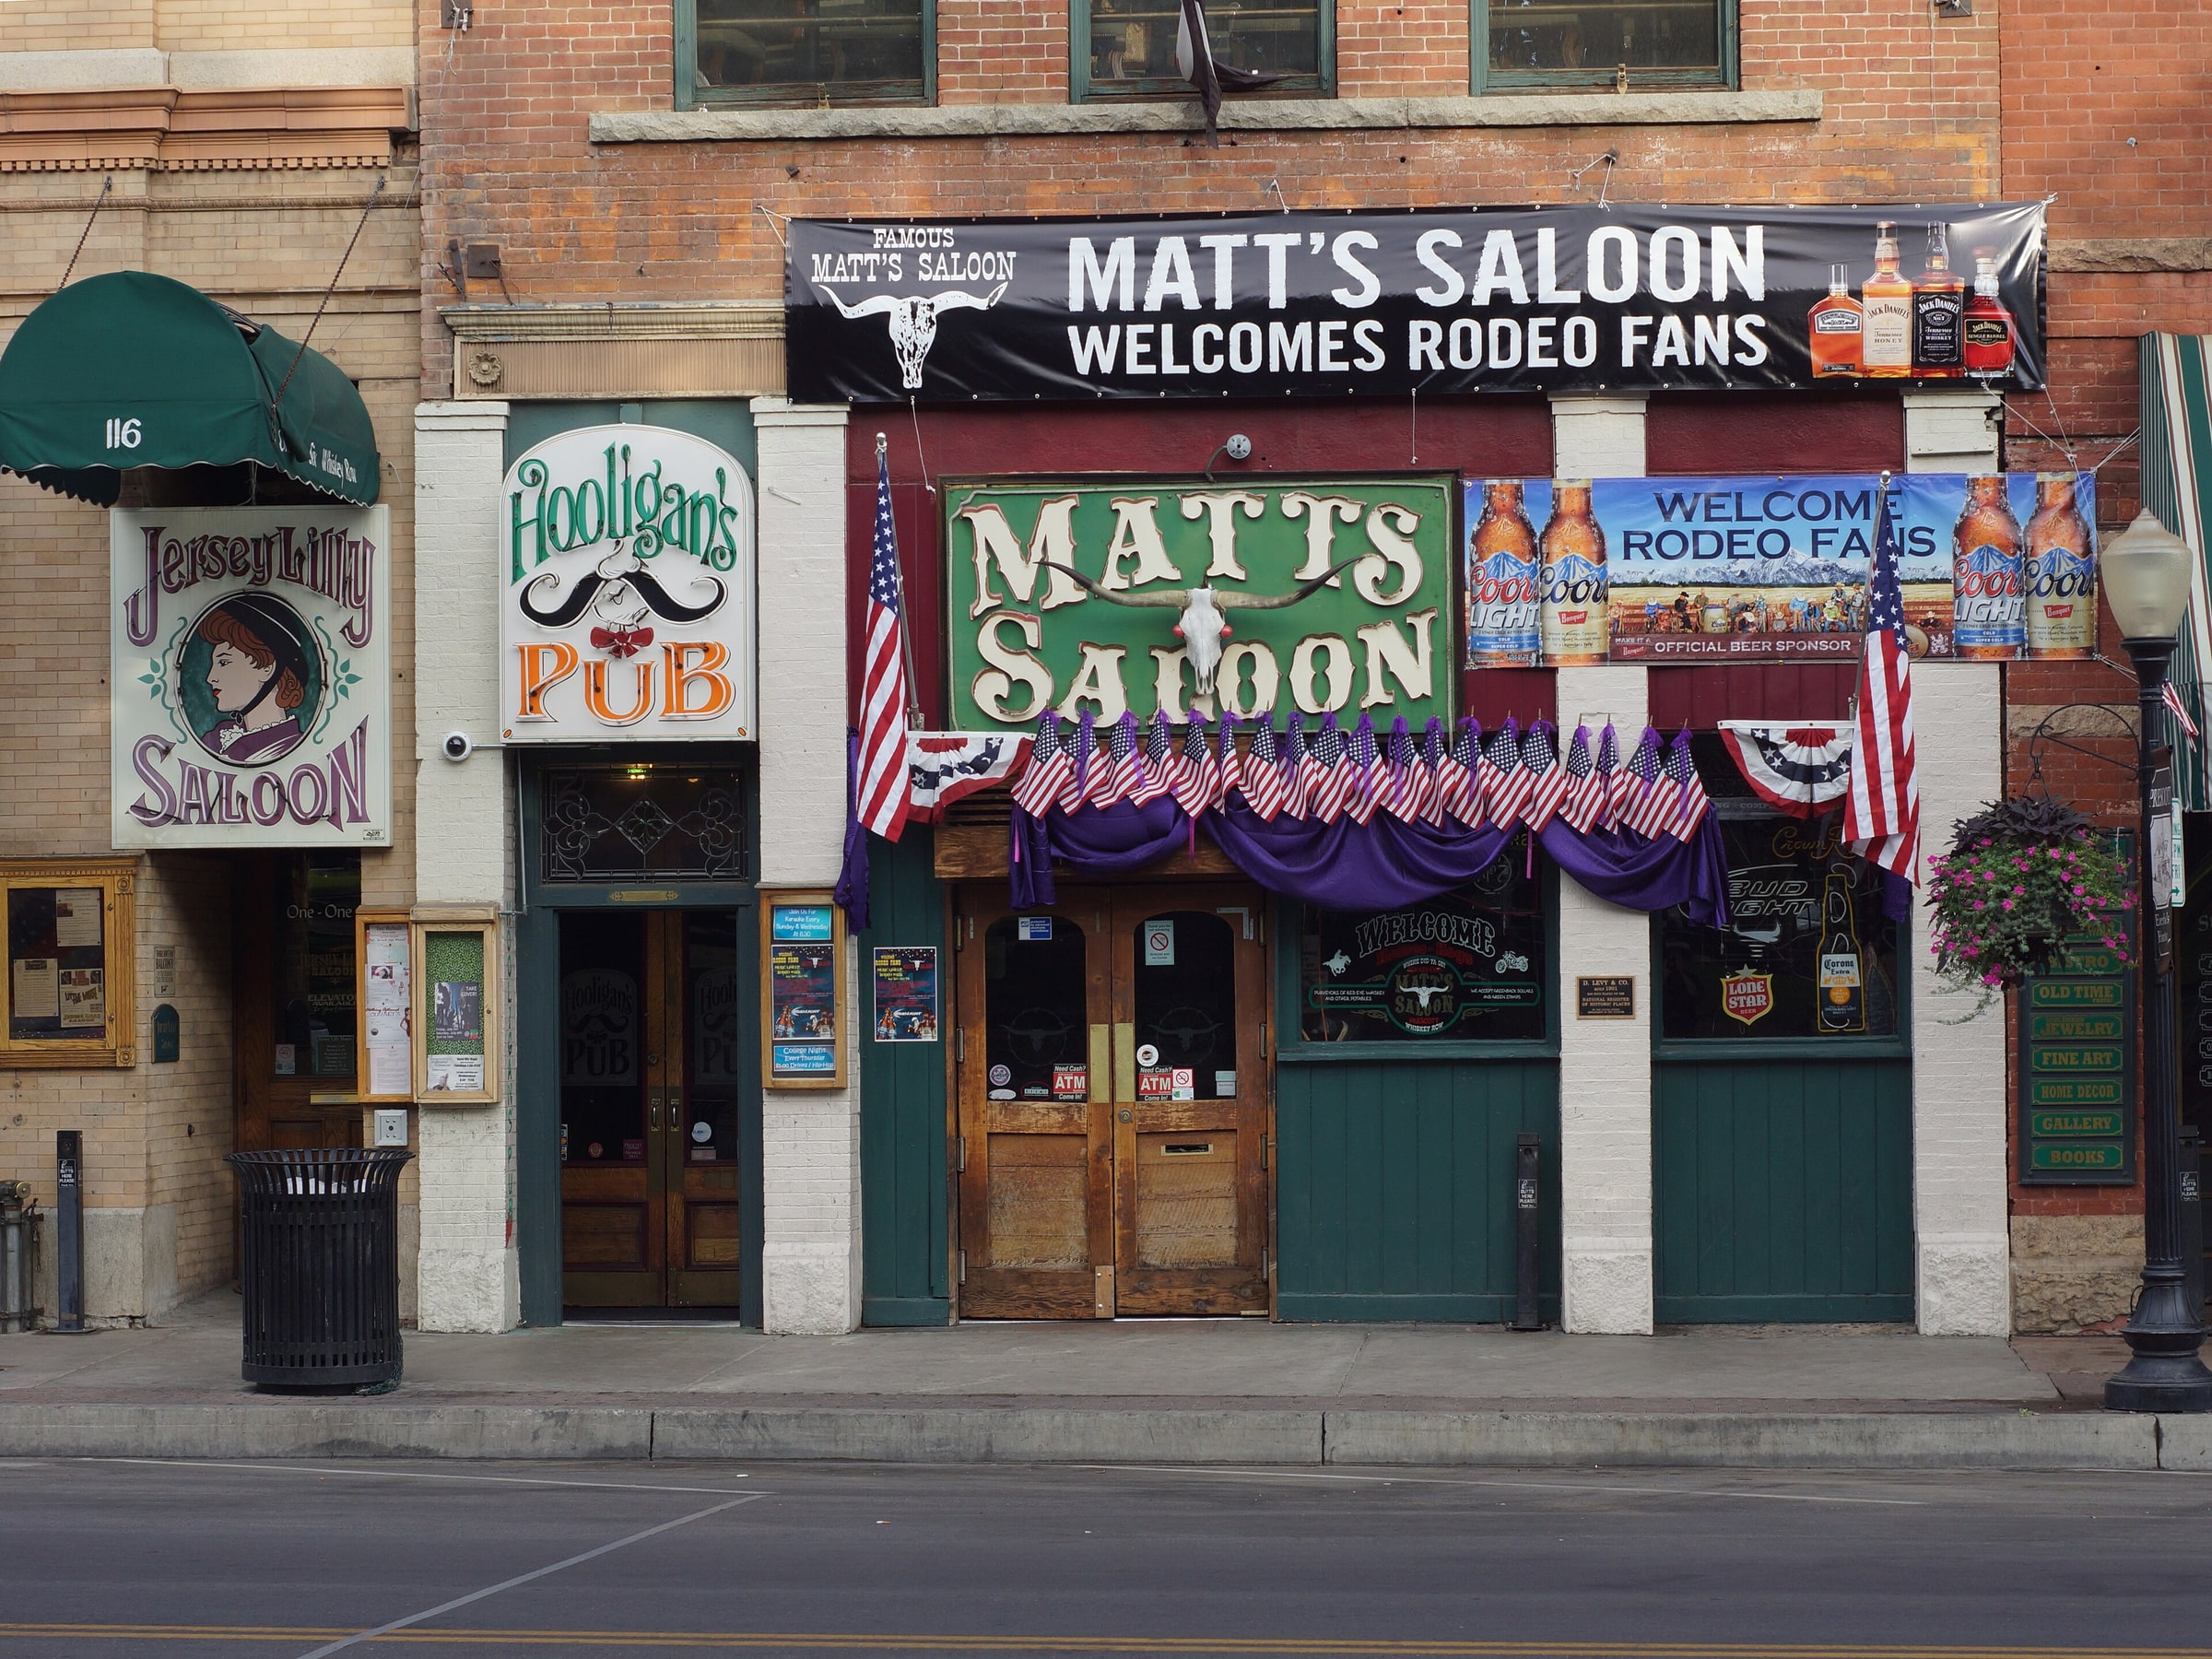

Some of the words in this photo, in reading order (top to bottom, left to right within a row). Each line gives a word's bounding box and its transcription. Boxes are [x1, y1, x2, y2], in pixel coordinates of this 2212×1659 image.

[873, 228, 955, 249] FAMOUS
[811, 253, 903, 282] MATT'S
[918, 251, 1017, 281] SALOON
[1068, 230, 1381, 312] MATT'S
[1415, 225, 1765, 308] SALOON
[1919, 301, 1935, 314] JACK
[1067, 319, 1385, 376] WELCOMES
[1408, 316, 1597, 371] RODEO
[1620, 313, 1768, 368] FANS
[106, 418, 142, 449] 116
[344, 458, 357, 484] Row
[510, 441, 738, 586] Hooligan's
[1653, 489, 1903, 523] WELCOME
[1622, 528, 1791, 560] RODEO
[124, 526, 274, 647] Jersey
[276, 526, 376, 648] Lilly
[1470, 606, 1539, 629] LIGHT
[1561, 612, 1585, 624] Banquet
[1954, 599, 2025, 622] LIGHT
[2047, 606, 2070, 617] Banquet
[1622, 646, 1645, 656] Banquet
[1654, 641, 1727, 653] OFFICIAL
[1730, 641, 1773, 653] BEER
[1775, 641, 1851, 653] SPONSOR
[971, 606, 1439, 729] SALOON
[512, 641, 736, 726] PUB
[125, 713, 371, 833] SALOON
[1729, 880, 1808, 897] BUD
[287, 902, 314, 919] One
[324, 902, 352, 919] One
[1729, 898, 1816, 916] IGHT
[1355, 912, 1495, 959] WELCOME
[1403, 958, 1419, 970] WHERE
[1824, 959, 1854, 970] Corona
[2047, 955, 2109, 968] BSTRO
[1394, 972, 1453, 994] MATT'S
[1729, 980, 1765, 995] LONE
[2039, 985, 2071, 998] OLD
[2074, 985, 2113, 998] TIME
[1394, 994, 1454, 1017] SALOON
[1728, 994, 1767, 1010] STAR
[1405, 1021, 1430, 1032] WHISKEY
[1431, 1021, 1444, 1032] ROW
[2040, 1022, 2114, 1037] JEWELRY
[566, 1038, 629, 1076] PUB
[700, 1038, 736, 1075] PU
[2041, 1052, 2079, 1065] FINE
[2081, 1052, 2112, 1065] ART
[1054, 1076, 1086, 1089] ATM
[1140, 1077, 1171, 1091] ATM
[2041, 1086, 2073, 1099] HOME
[2077, 1086, 2114, 1099] DECOR
[2041, 1117, 2112, 1131] GALLERY
[2050, 1150, 2105, 1163] BOOKS
